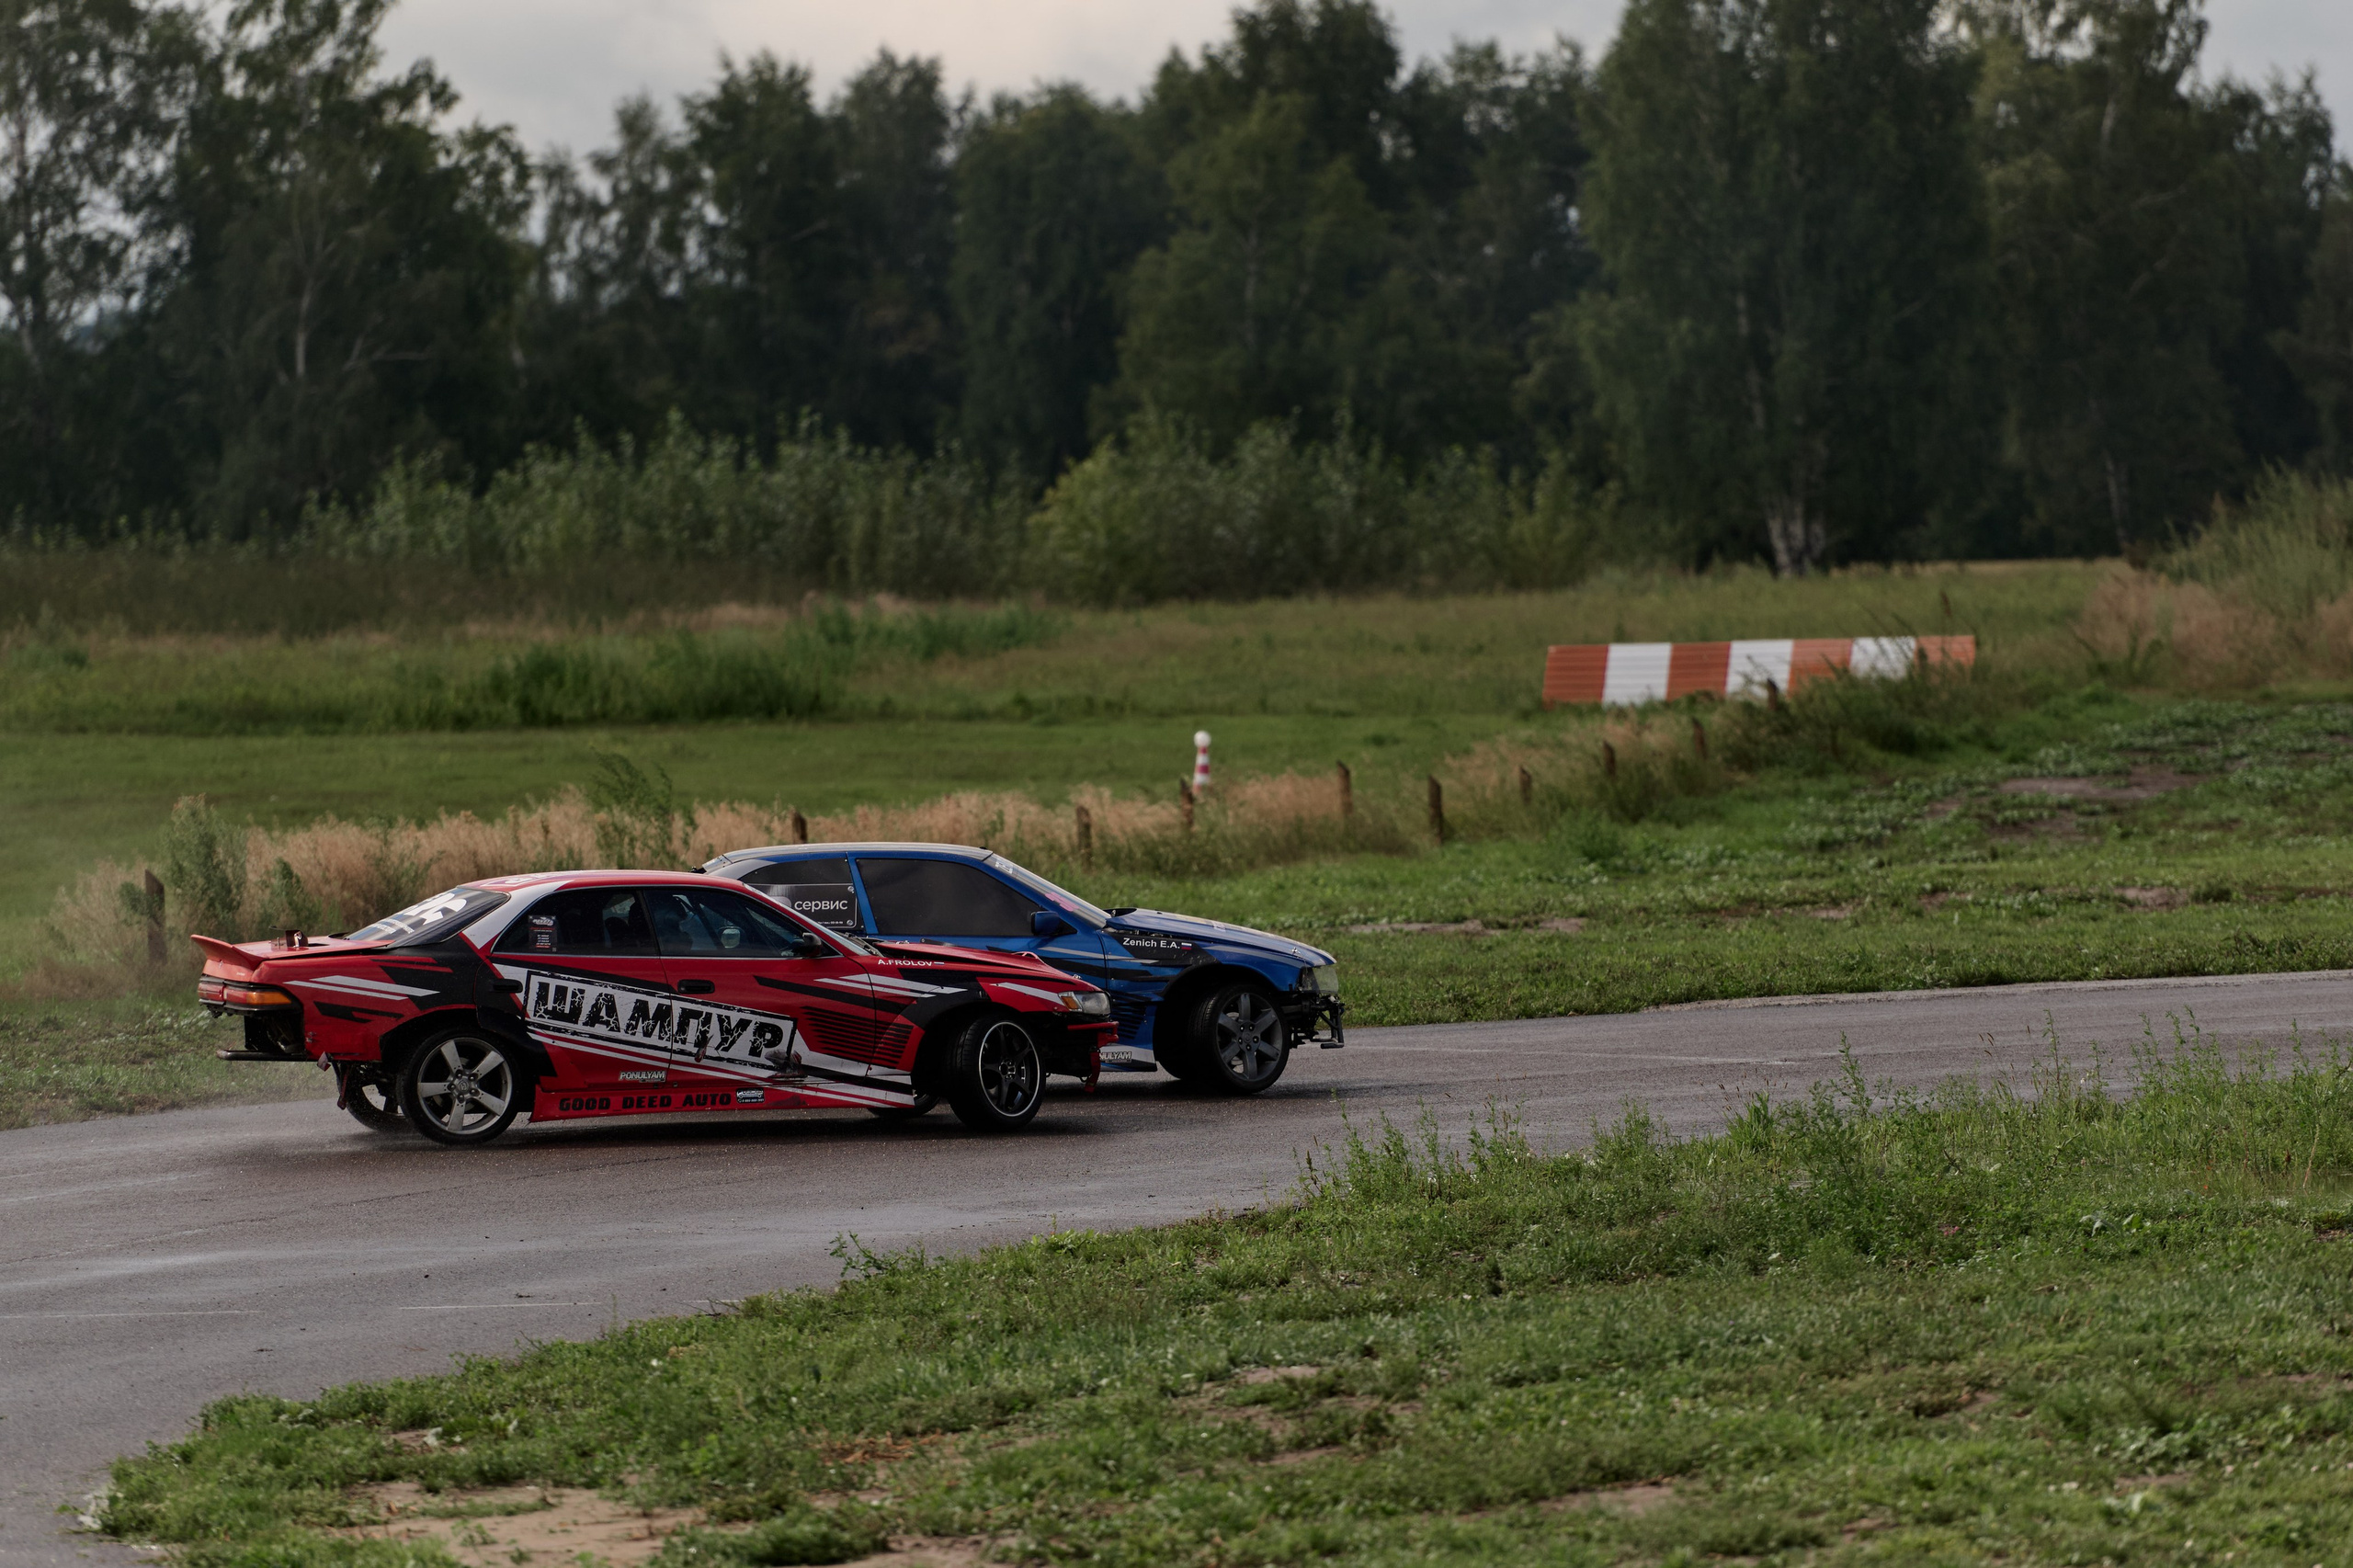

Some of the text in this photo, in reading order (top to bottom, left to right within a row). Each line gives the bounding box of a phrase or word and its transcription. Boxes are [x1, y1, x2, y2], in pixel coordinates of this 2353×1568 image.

[794, 900, 848, 913] сервис
[1122, 937, 1180, 949] Zenich E.A.
[532, 981, 784, 1058] ШАМПУР
[620, 1071, 665, 1080] PONULYAM
